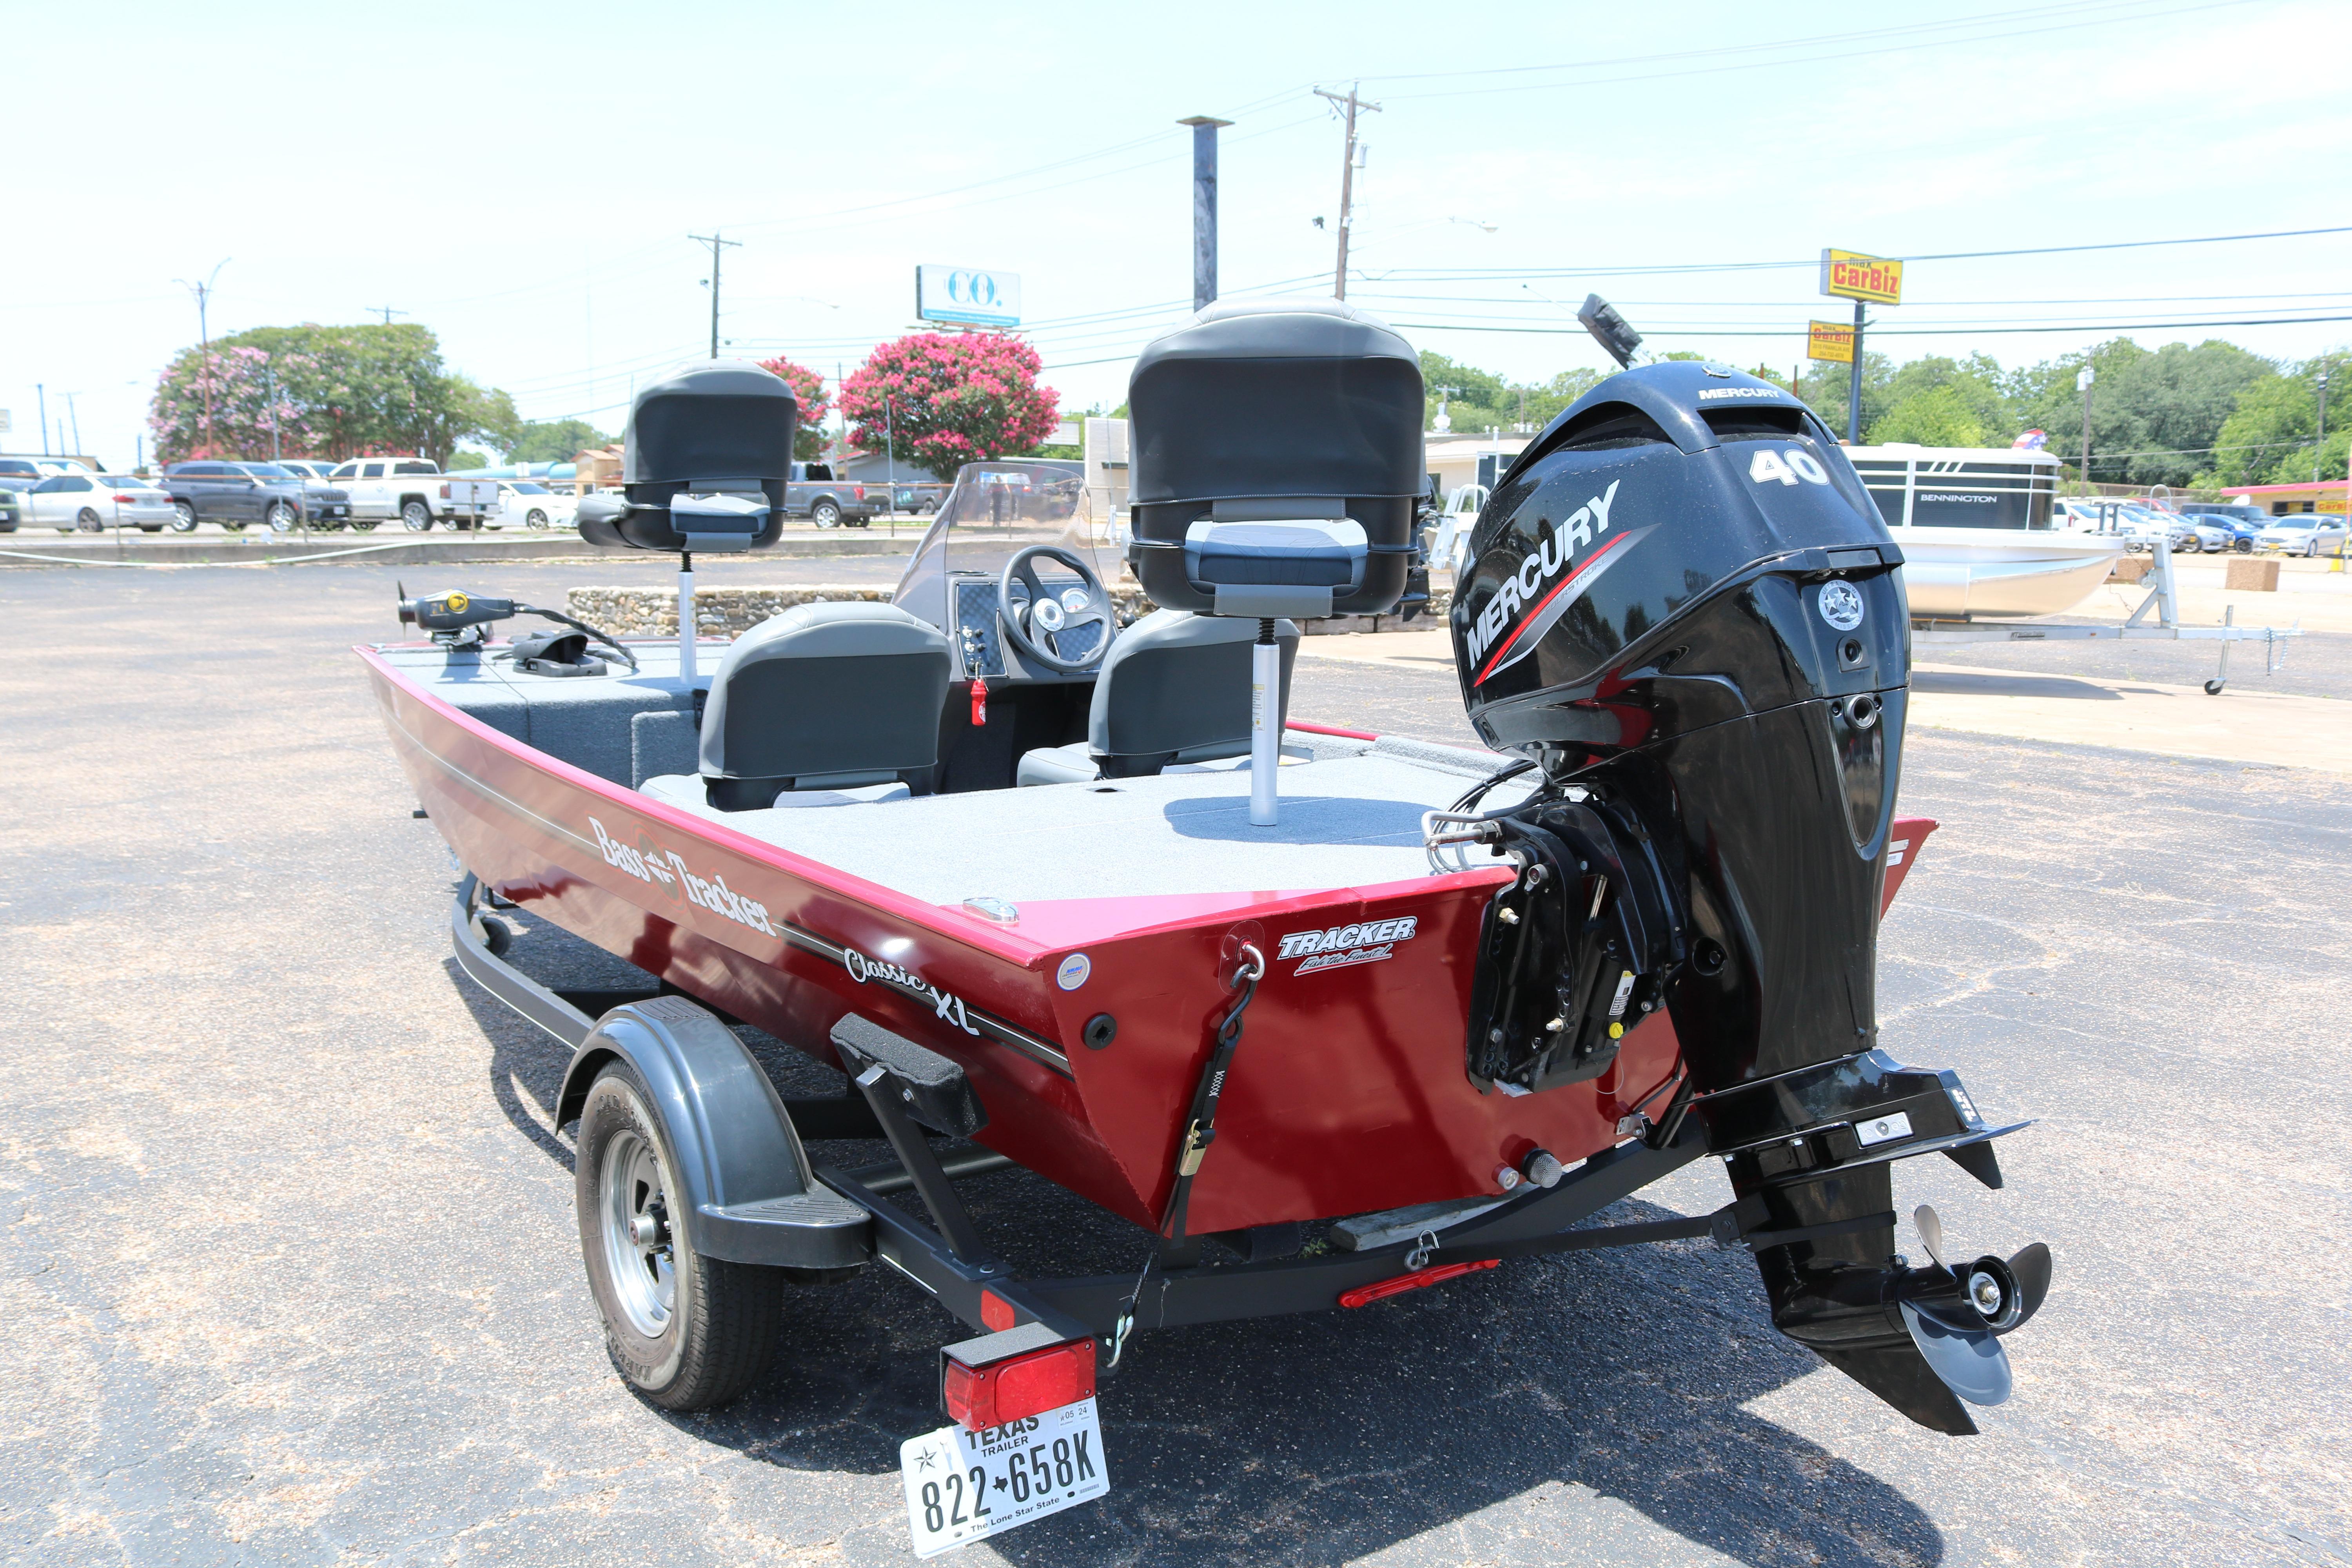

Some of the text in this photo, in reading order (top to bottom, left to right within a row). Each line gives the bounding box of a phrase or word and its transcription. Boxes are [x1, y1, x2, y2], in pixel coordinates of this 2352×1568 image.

[1834, 263, 1898, 294] CarBiz
[1814, 327, 1851, 343] CarBiz
[1699, 389, 1780, 399] MERCURY
[1749, 449, 1830, 486] 40
[1921, 494, 1997, 503] BENNINGTON
[1466, 479, 1620, 671] MERCURY
[1544, 554, 1608, 616] FOURSTROKE
[1822, 581, 1857, 595] ULTRA LOW
[588, 816, 777, 937] Bass Tracker
[1279, 918, 1416, 959] TRACKER
[1301, 958, 1325, 969] Fish
[1327, 953, 1343, 965] the
[843, 948, 980, 1036] Classic XL
[1065, 1410, 1074, 1419] 05
[1078, 1406, 1087, 1416] 24
[965, 1416, 1039, 1450] TEXAS
[981, 1436, 1029, 1458] TRAILER
[922, 1429, 1096, 1533] 822 658K
[970, 1497, 1060, 1533] The Lone Star State
